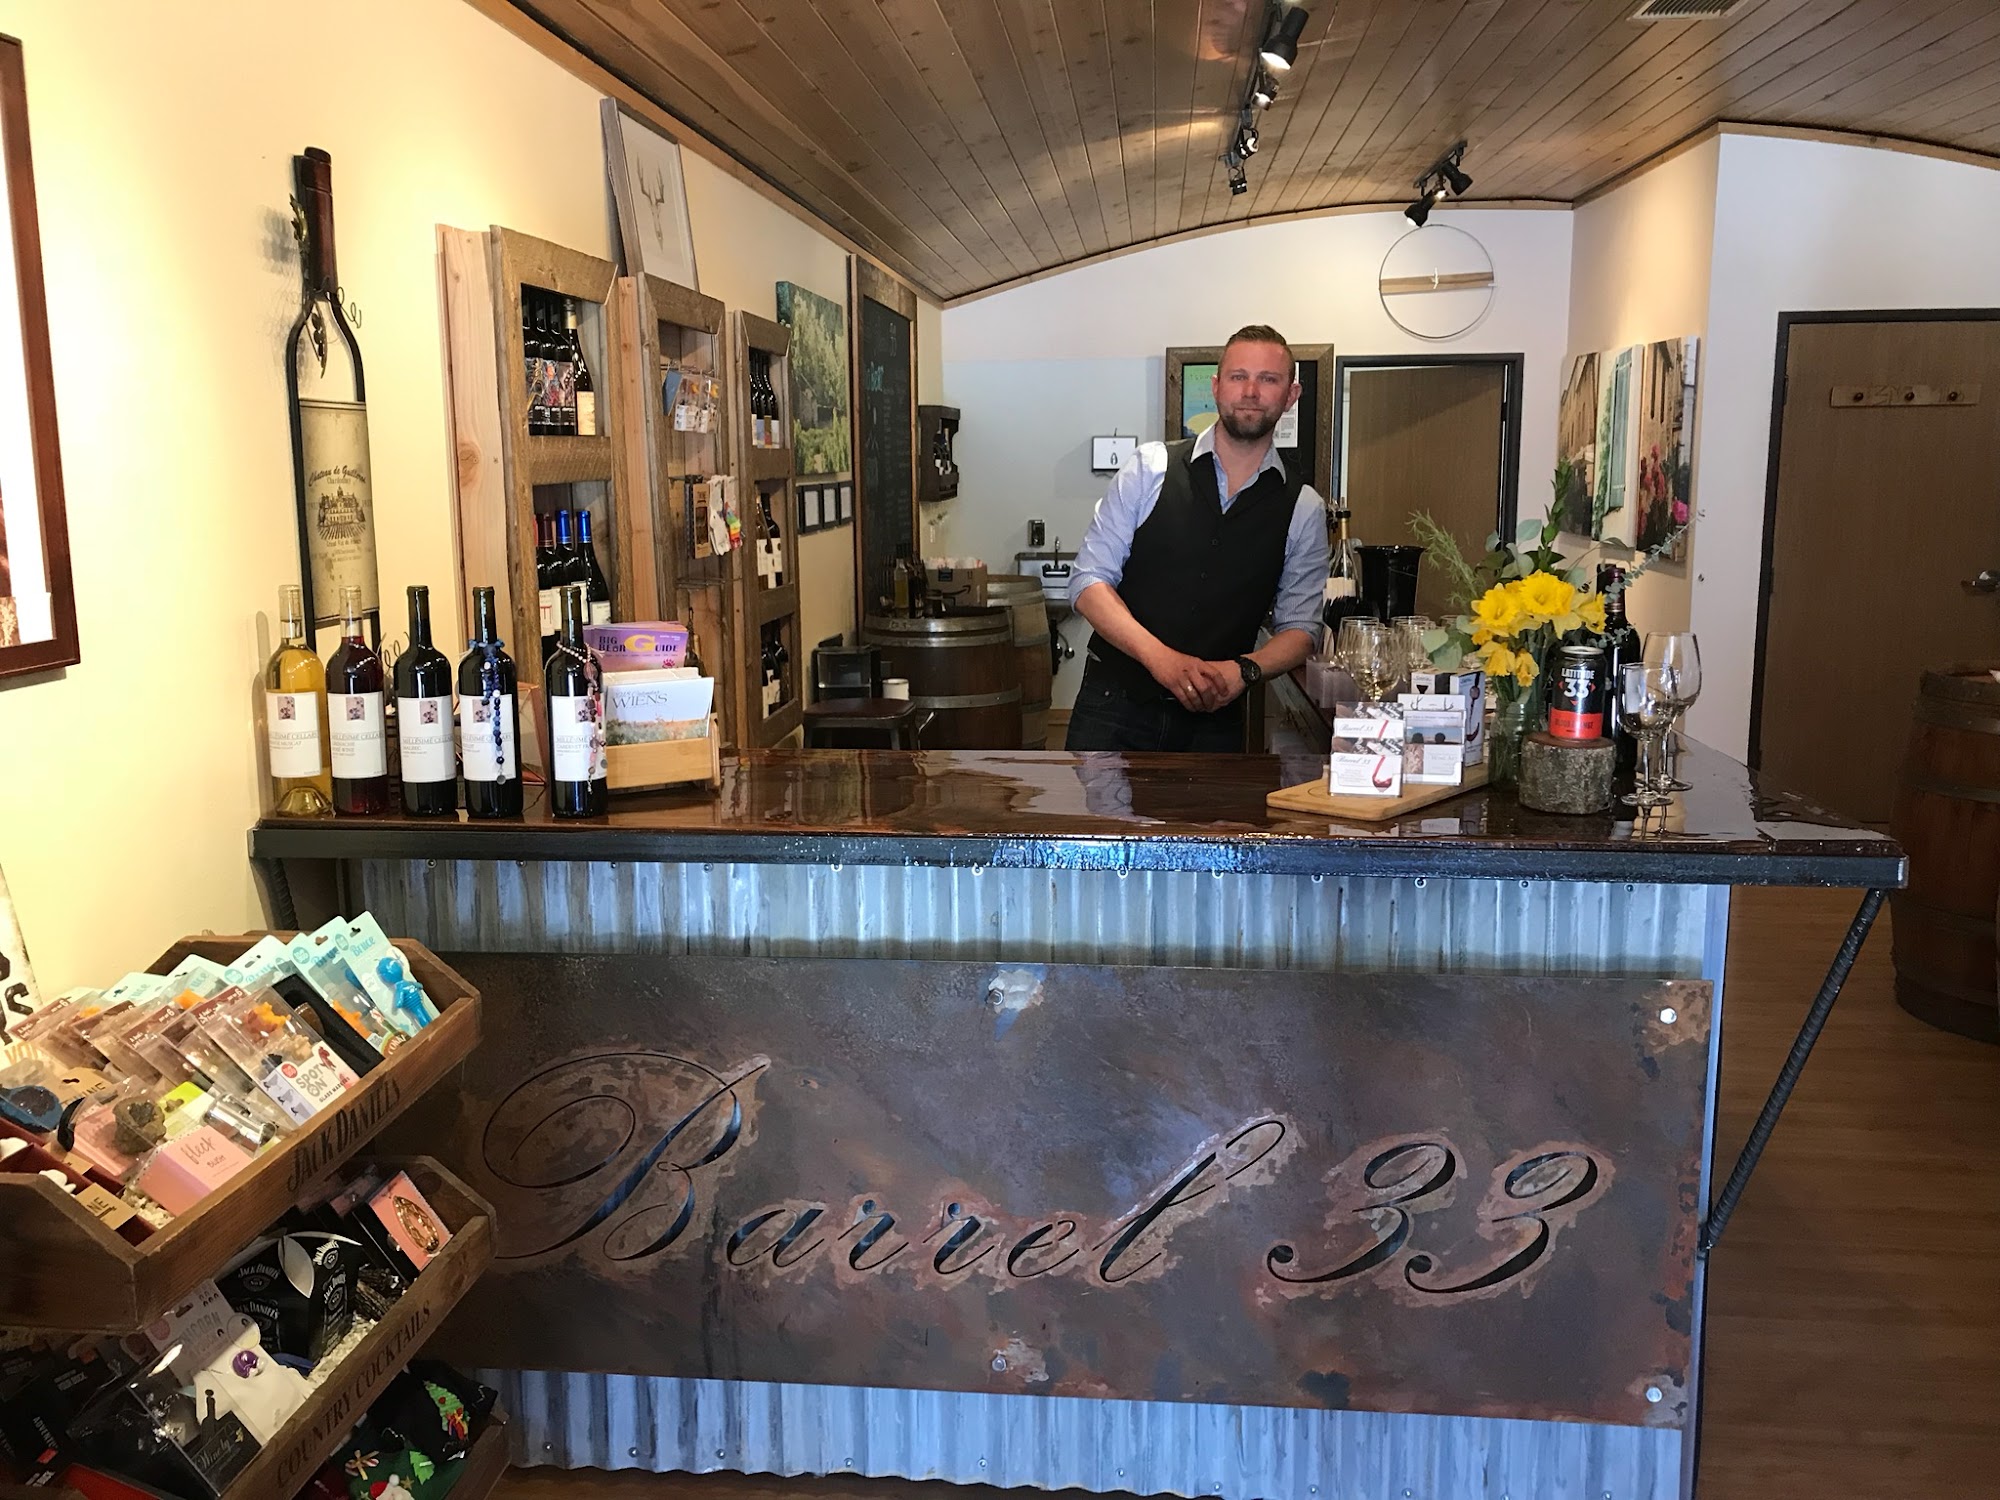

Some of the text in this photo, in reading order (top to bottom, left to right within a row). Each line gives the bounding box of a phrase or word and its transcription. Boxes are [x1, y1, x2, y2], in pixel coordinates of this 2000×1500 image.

[599, 636, 618, 645] BIG
[1561, 667, 1595, 680] LATITUDE
[612, 693, 668, 709] WIENS
[296, 1063, 324, 1089] SPOT
[306, 1076, 329, 1097] ON
[287, 1126, 334, 1192] JACK
[482, 1052, 1598, 1293] Barrel 33
[276, 1299, 431, 1489] COUNTRY COCKTAILS
